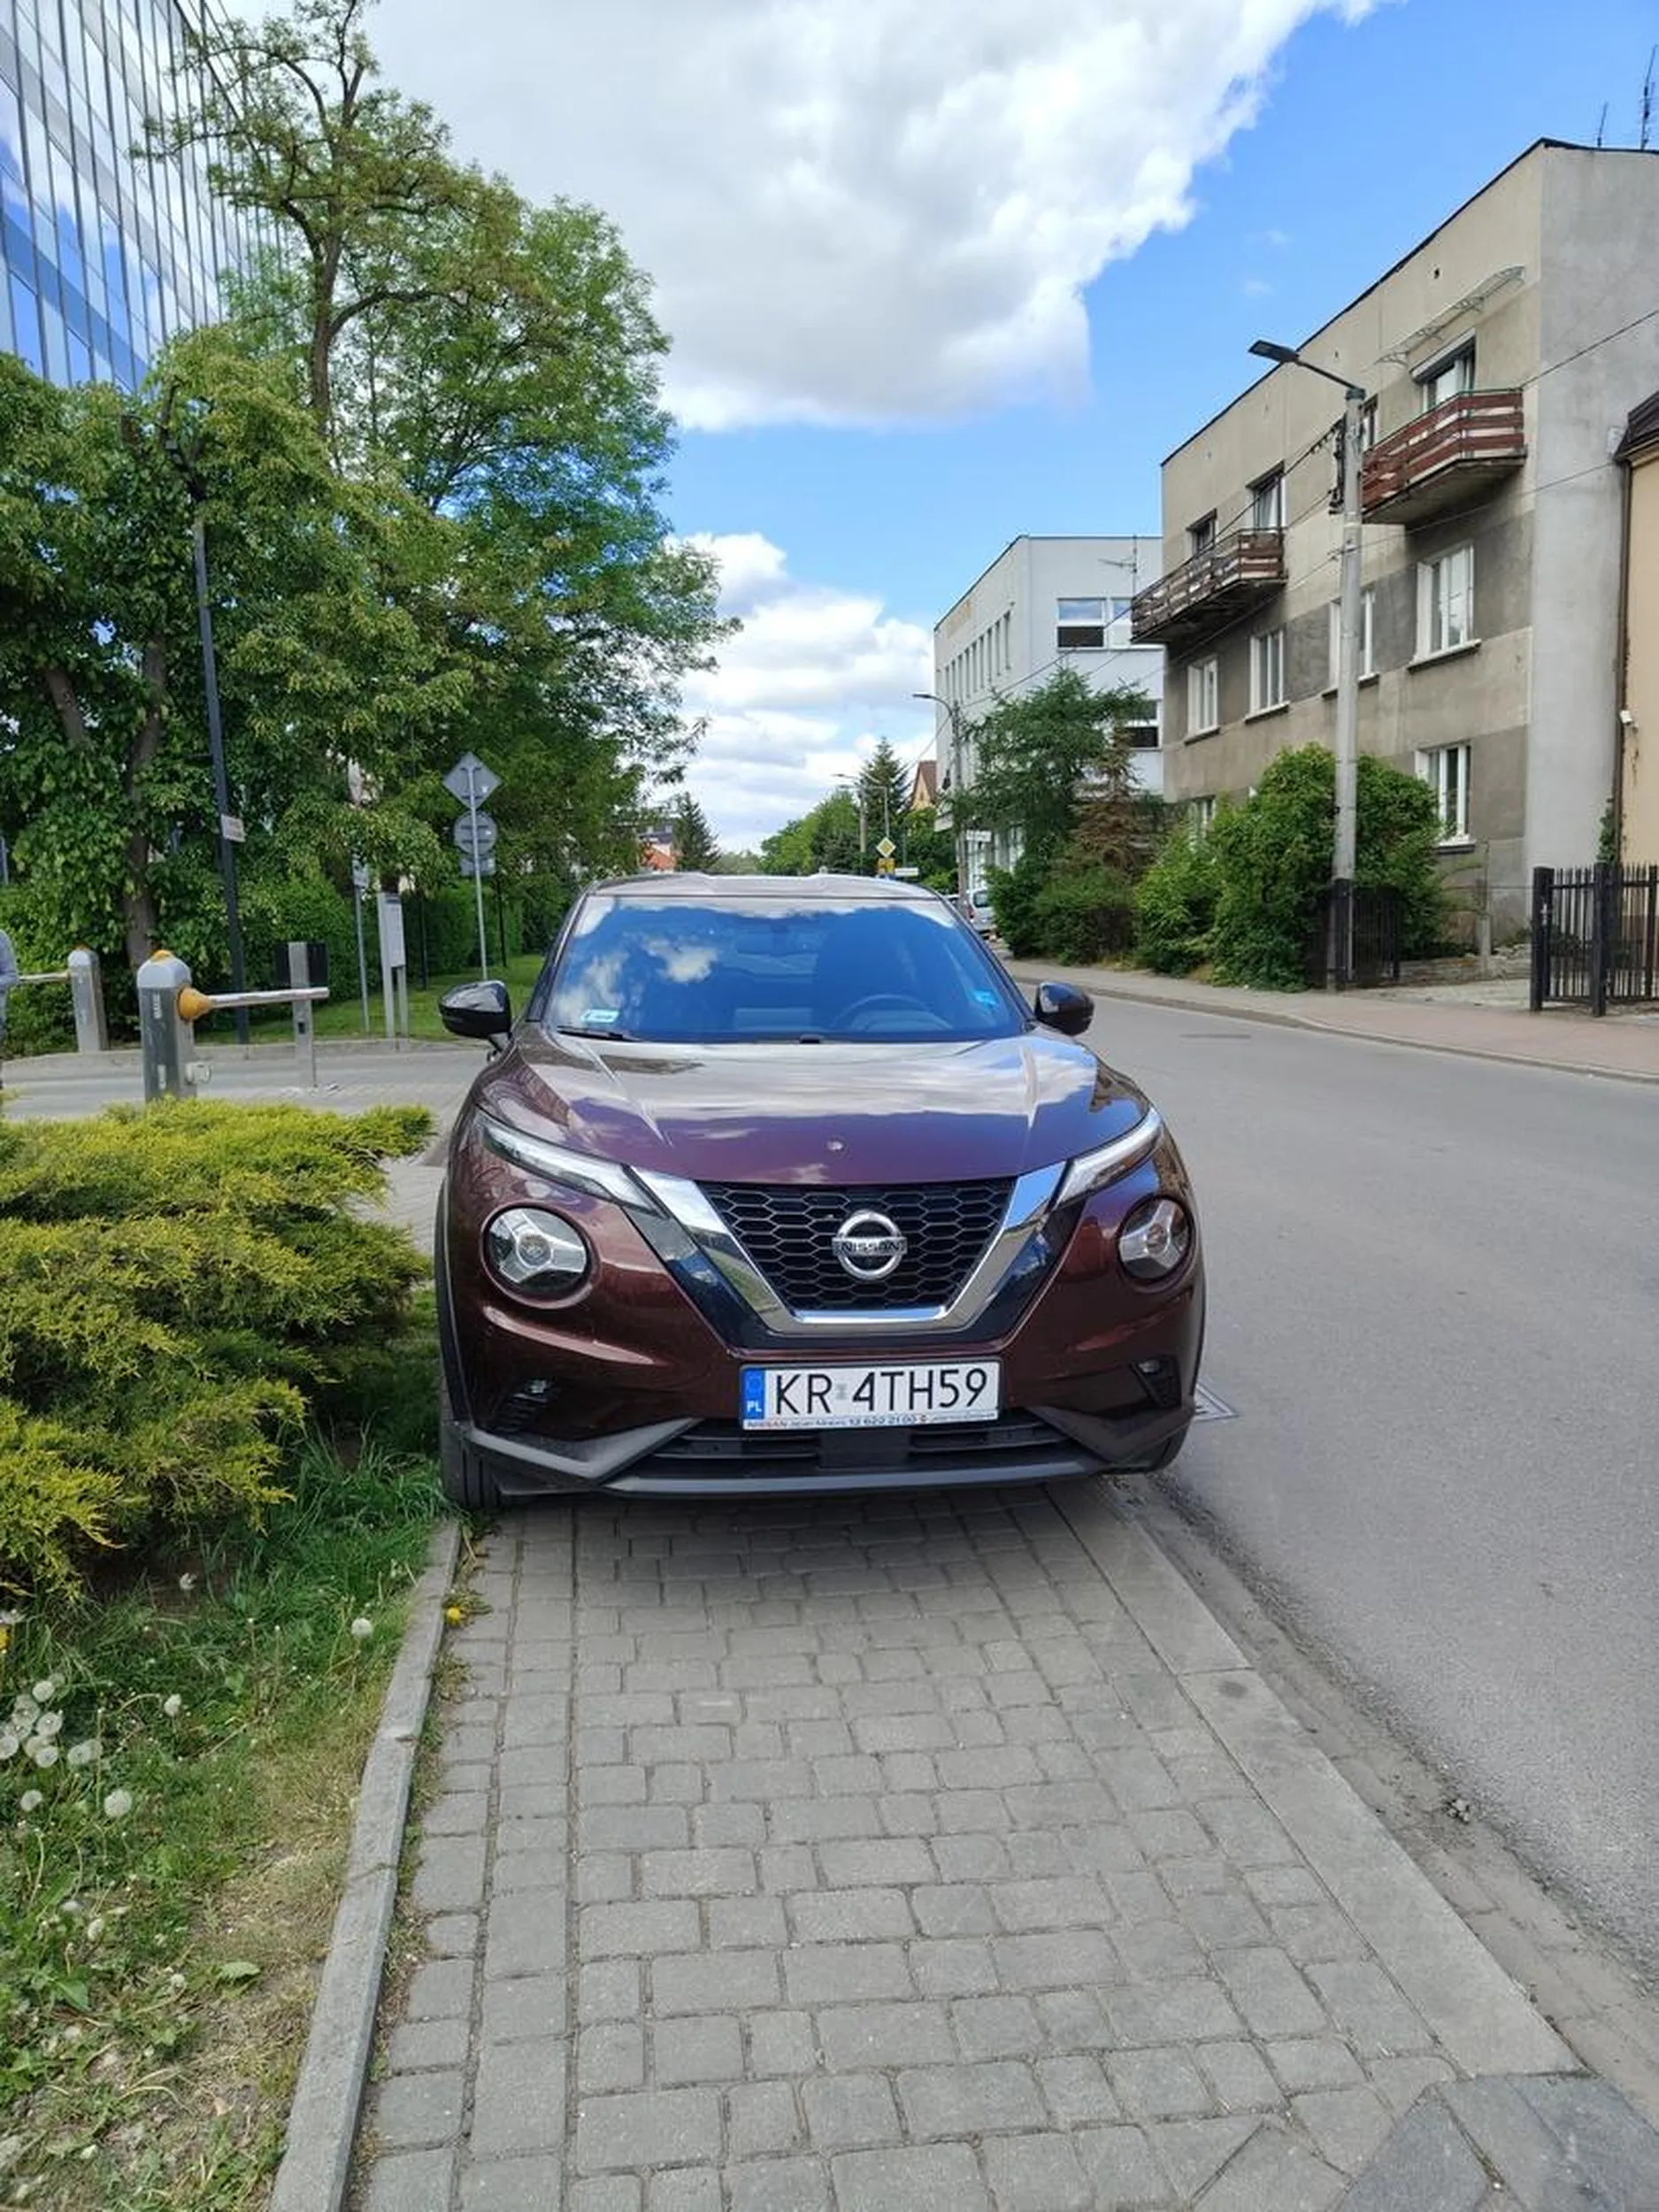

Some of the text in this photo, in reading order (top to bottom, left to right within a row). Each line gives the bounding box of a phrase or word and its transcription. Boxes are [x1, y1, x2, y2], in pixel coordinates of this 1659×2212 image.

[841, 1240, 901, 1252] NISSAN
[775, 1367, 987, 1415] KR 4TH59
[747, 1401, 762, 1413] PL
